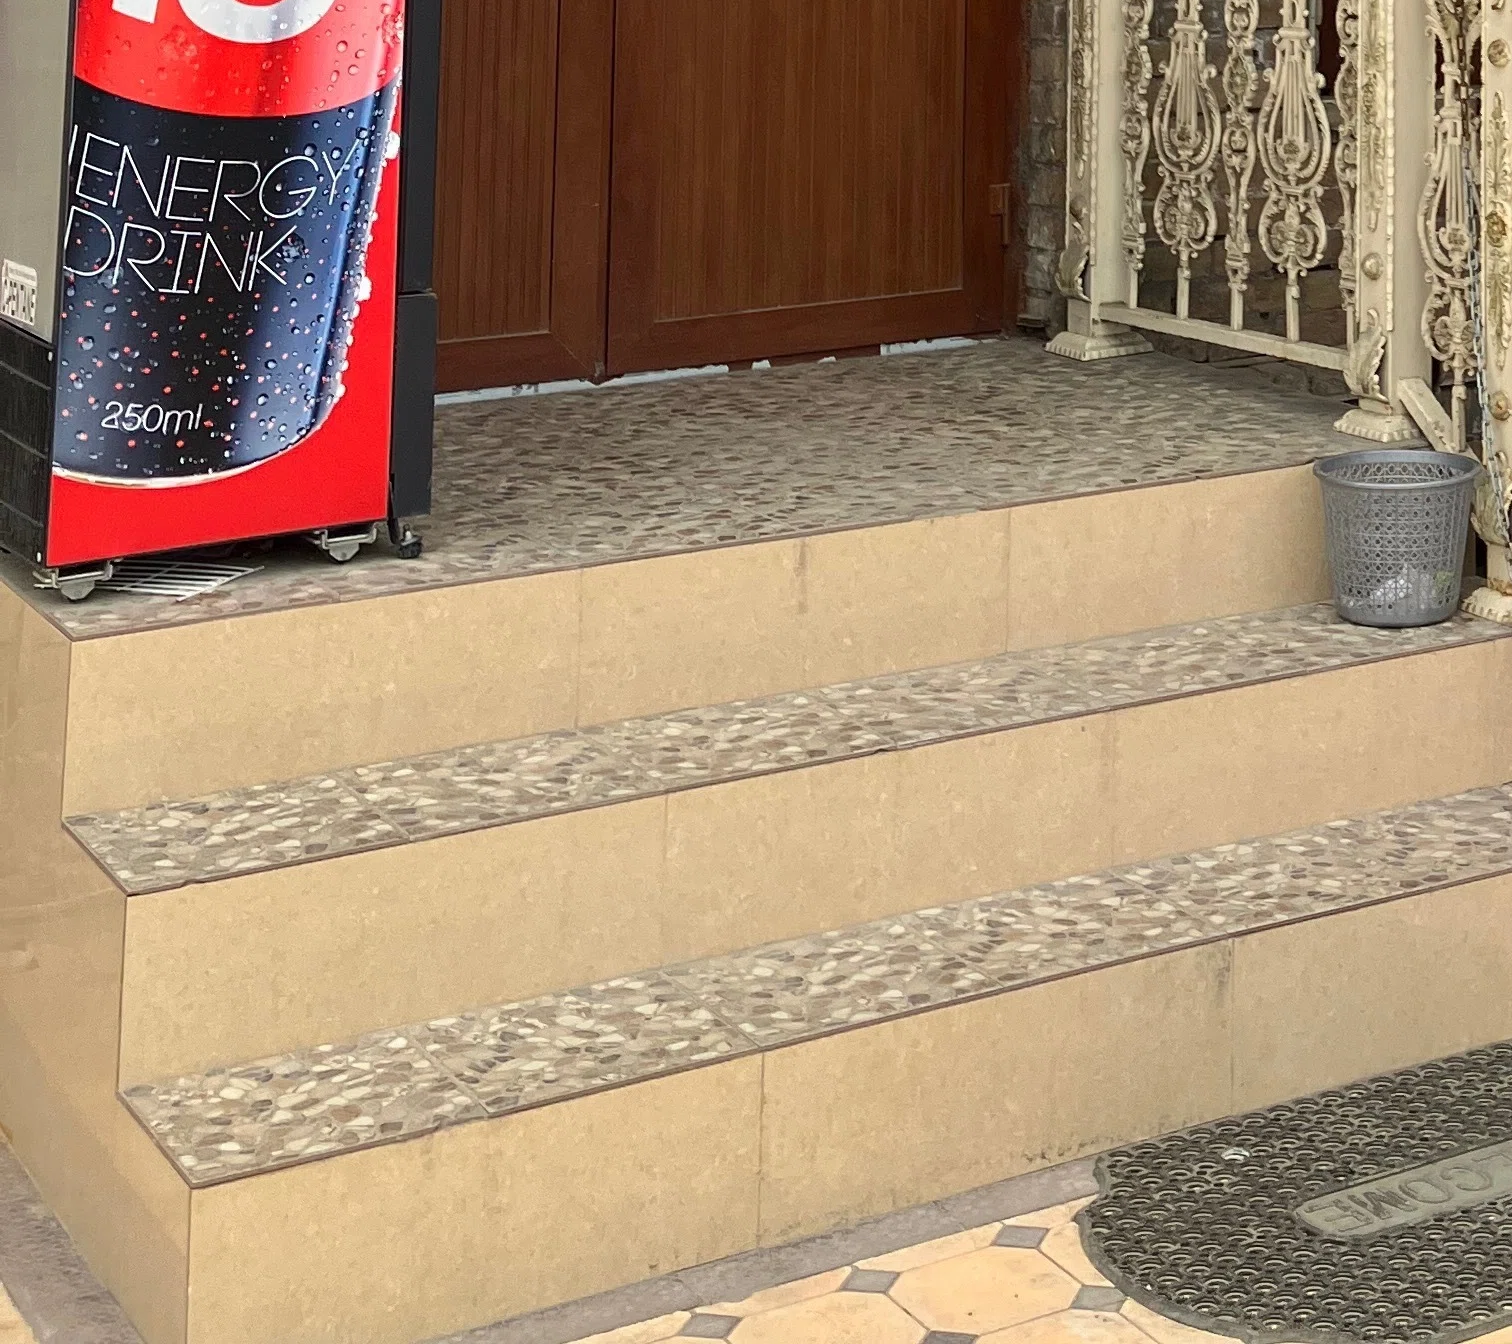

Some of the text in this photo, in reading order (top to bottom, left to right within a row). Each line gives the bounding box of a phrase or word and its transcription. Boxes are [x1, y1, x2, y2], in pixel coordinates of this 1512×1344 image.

[75, 132, 361, 223] ENERGY
[63, 205, 298, 296] DRINK
[101, 401, 203, 436] 250ml
